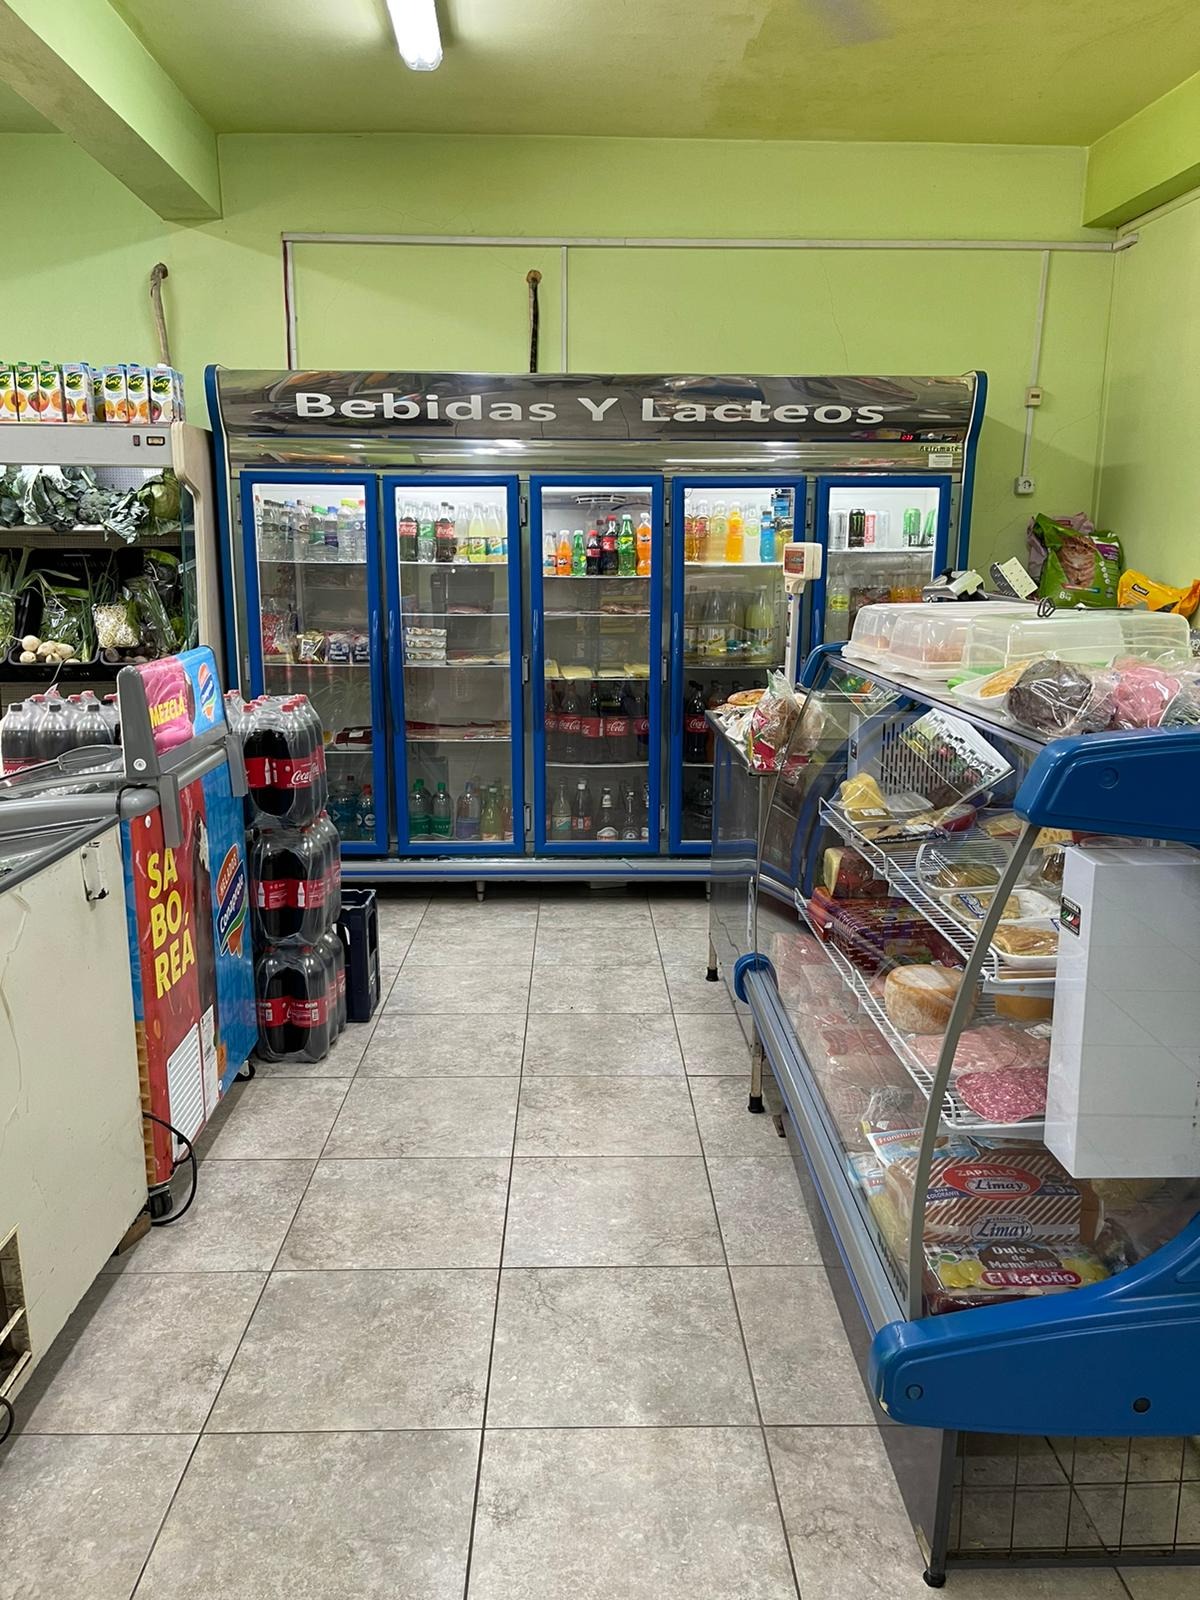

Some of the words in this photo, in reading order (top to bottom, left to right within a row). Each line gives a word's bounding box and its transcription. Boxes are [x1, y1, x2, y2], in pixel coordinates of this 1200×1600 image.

[295, 391, 557, 423] Bebidas
[577, 397, 618, 422] Y
[641, 396, 884, 425] Lacteos
[956, 1168, 1018, 1178] ZAPALLO
[975, 1178, 1025, 1191] Limay
[977, 1219, 1030, 1238] Limay
[992, 1245, 1035, 1256] Dulce
[1011, 1254, 1026, 1263] de
[987, 1272, 1003, 1285] El
[1010, 1269, 1076, 1286] Retoño
